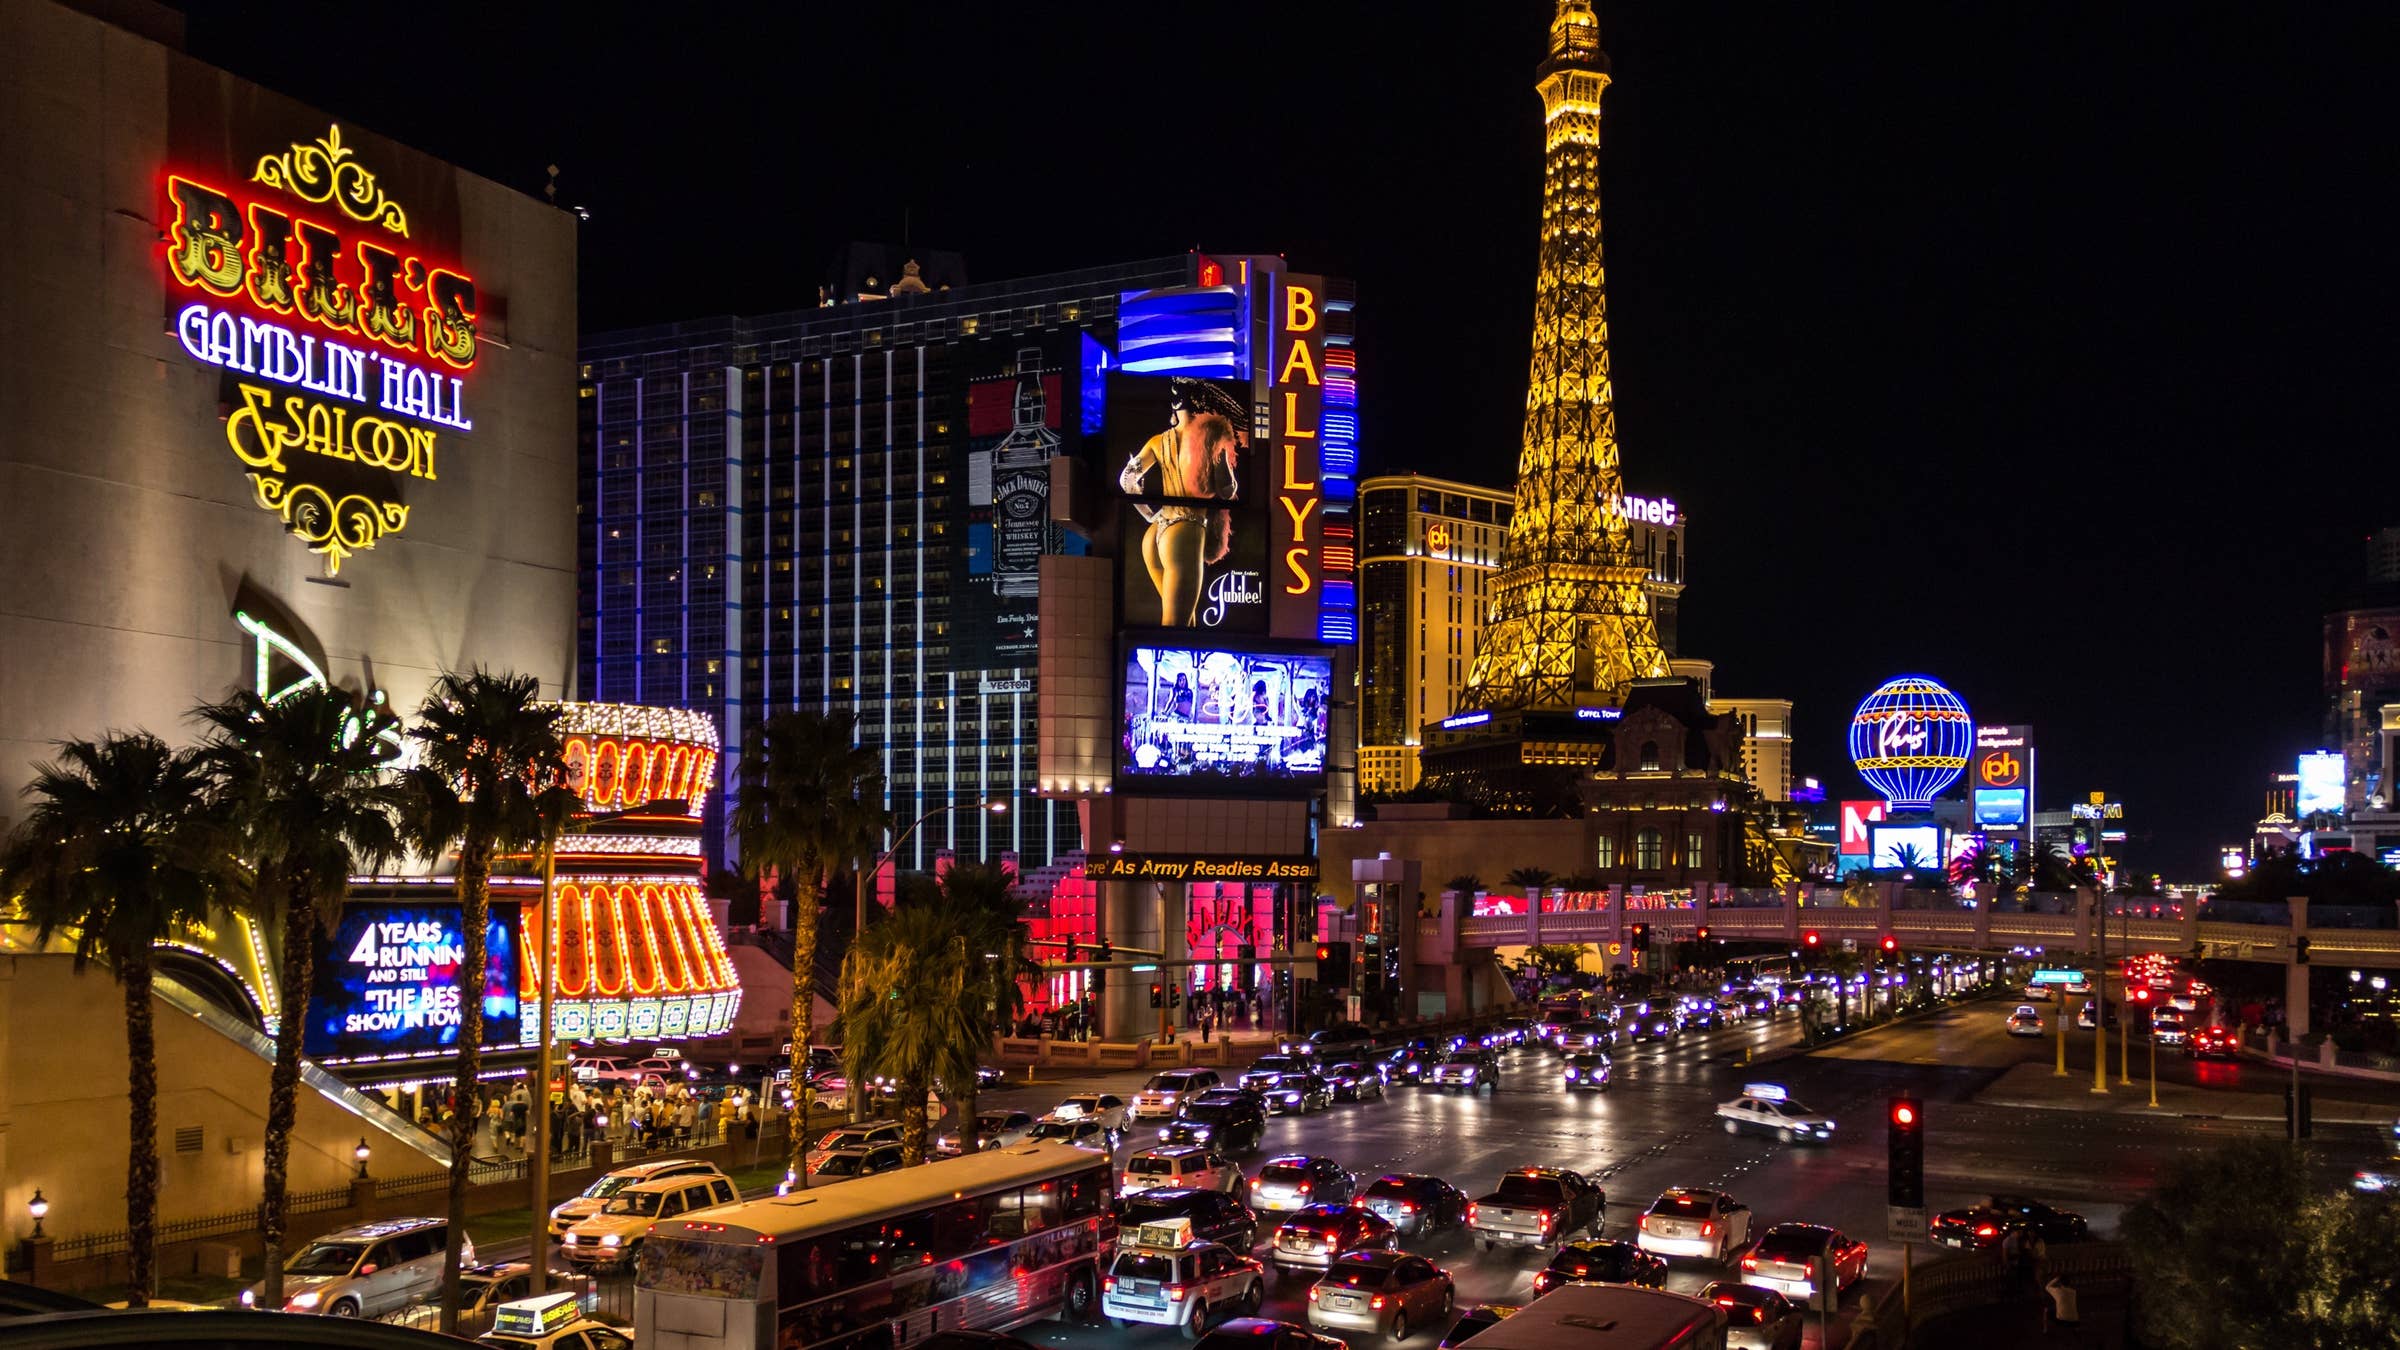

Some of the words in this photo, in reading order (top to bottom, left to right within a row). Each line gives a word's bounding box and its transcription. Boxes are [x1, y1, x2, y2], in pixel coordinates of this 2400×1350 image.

[168, 175, 478, 369] BILL'S
[178, 305, 381, 404] GAMBLIN'
[380, 359, 472, 431] HALL
[227, 384, 287, 473] &
[281, 397, 438, 481] SALOON
[1280, 286, 1320, 594] BALLYS
[997, 480, 1016, 500] JACK
[1005, 532, 1039, 540] WHISKEY
[1430, 525, 1449, 549] ph
[1203, 572, 1262, 626] Jubilee!
[990, 681, 1029, 690] VECTOR
[1985, 752, 2020, 782] ph
[1085, 860, 1109, 876] cre'
[1112, 859, 1136, 875] As
[1140, 859, 1189, 879] Army
[1193, 860, 1262, 877] Readies
[348, 922, 378, 967] 4
[378, 922, 442, 944] YEARS
[379, 945, 465, 967] RUNNIN
[366, 970, 398, 983] AND
[400, 968, 428, 982] STILL
[421, 986, 462, 1010] BES
[345, 1013, 401, 1032] SHOW
[403, 1012, 423, 1028] IN
[426, 1008, 462, 1027] TOW
